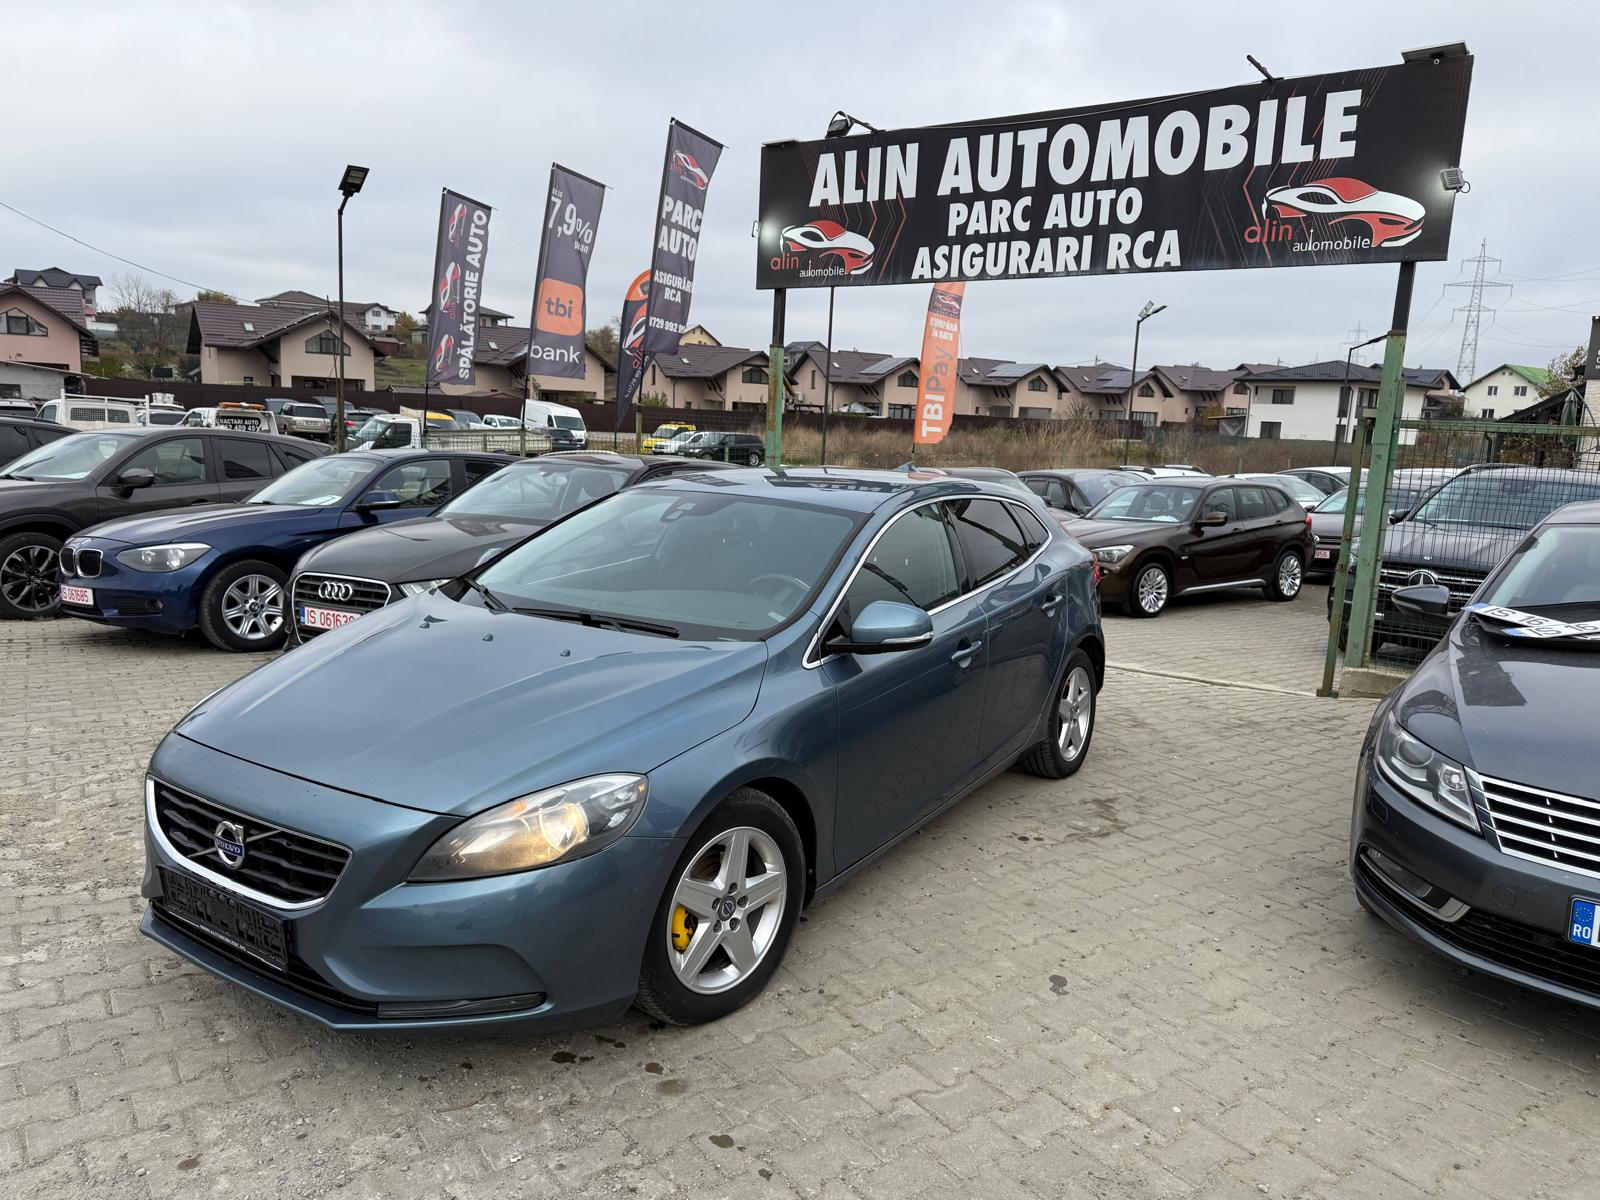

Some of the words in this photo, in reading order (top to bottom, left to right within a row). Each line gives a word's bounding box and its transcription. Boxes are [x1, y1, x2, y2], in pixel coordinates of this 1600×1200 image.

[808, 142, 919, 207] ALIN
[937, 89, 1362, 196] AUTOMOBILE
[548, 196, 593, 243] 7,9%
[662, 194, 703, 233] PARC
[948, 196, 1032, 237] PARC
[1043, 187, 1143, 230] AUTO
[466, 209, 488, 268] AUTO
[1244, 218, 1293, 243] alin
[1293, 231, 1371, 252] automobile
[657, 226, 698, 261] AUTO
[911, 235, 1093, 280] ASIGURARI
[1106, 230, 1181, 270] RCA
[770, 252, 799, 271] alin
[800, 262, 844, 278] automobile
[664, 287, 682, 303] RCA
[545, 298, 573, 319] tbi
[457, 270, 480, 379] SPĂLĂTORIE
[530, 340, 580, 364] bank
[921, 348, 953, 437] TBIPay
[306, 609, 316, 625] IS
[1483, 607, 1516, 617] IS
[1526, 627, 1562, 637] IS
[216, 839, 241, 854] VOLVO
[1573, 923, 1591, 939] RO
